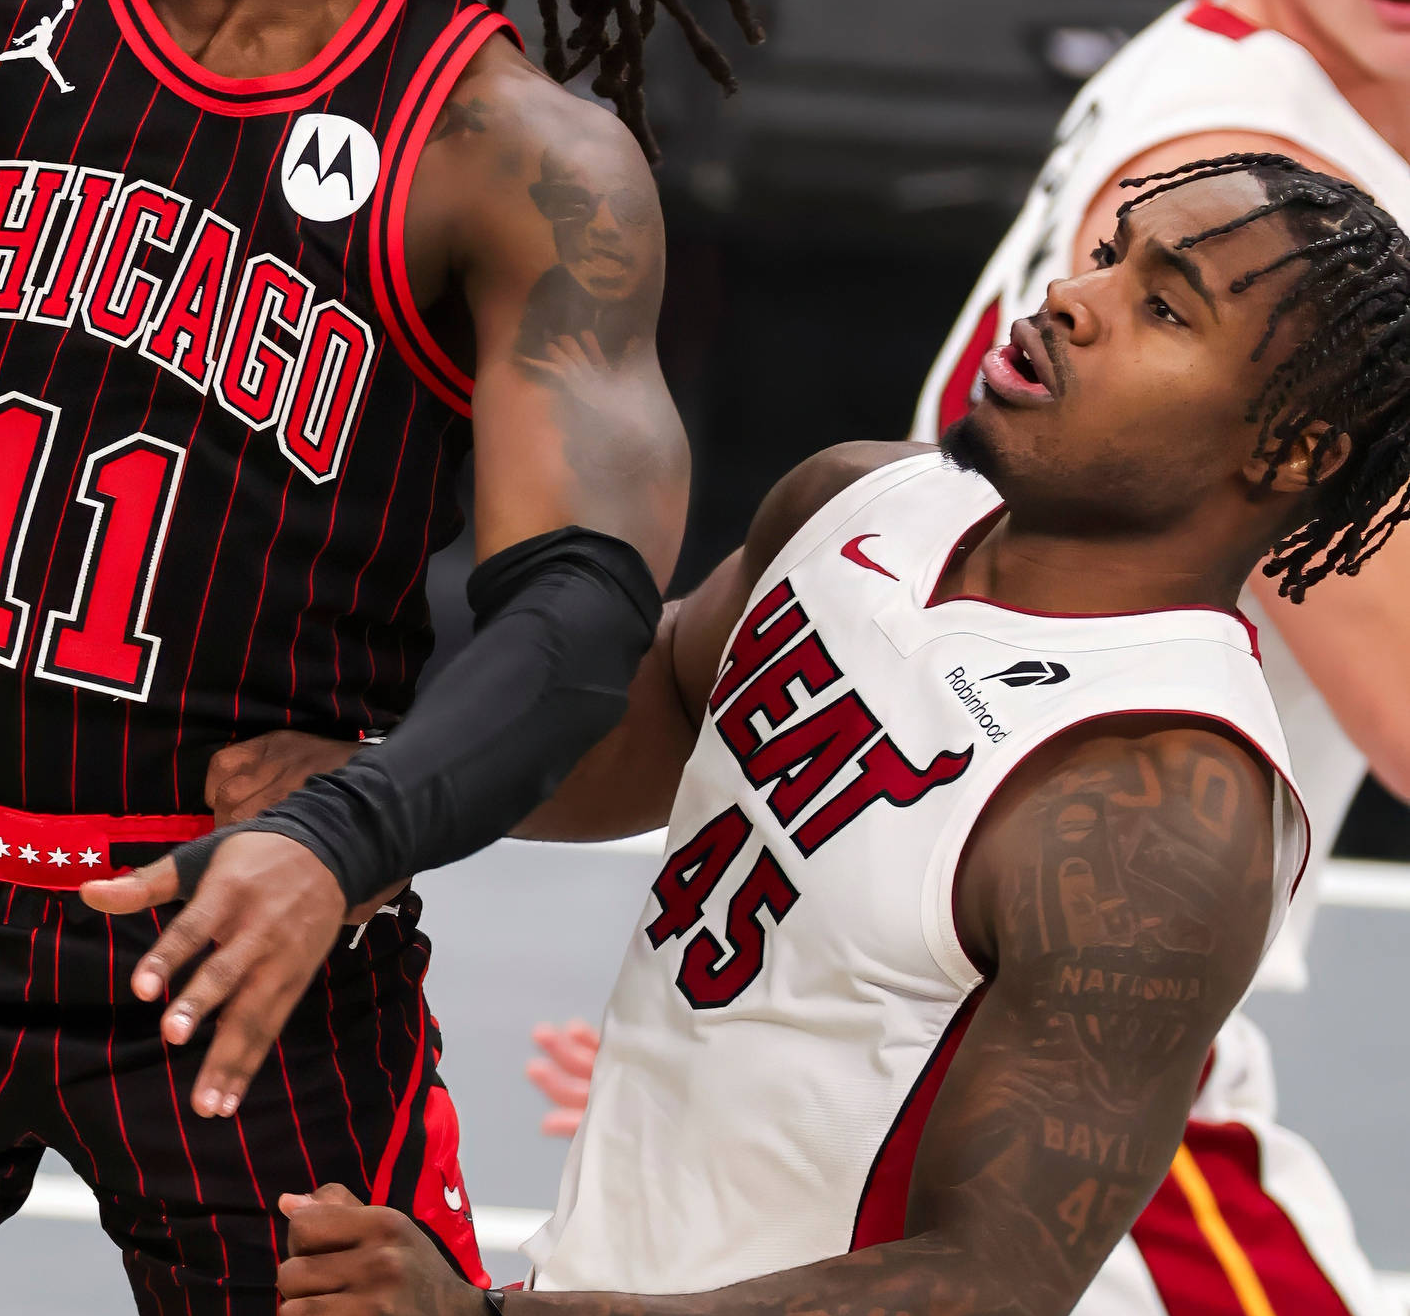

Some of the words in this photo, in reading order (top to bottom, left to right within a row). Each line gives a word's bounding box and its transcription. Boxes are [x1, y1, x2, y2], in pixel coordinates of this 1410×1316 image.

[708, 576, 975, 860] HEAT
[944, 666, 1013, 744] Robinhood
[644, 802, 802, 1010] 45
